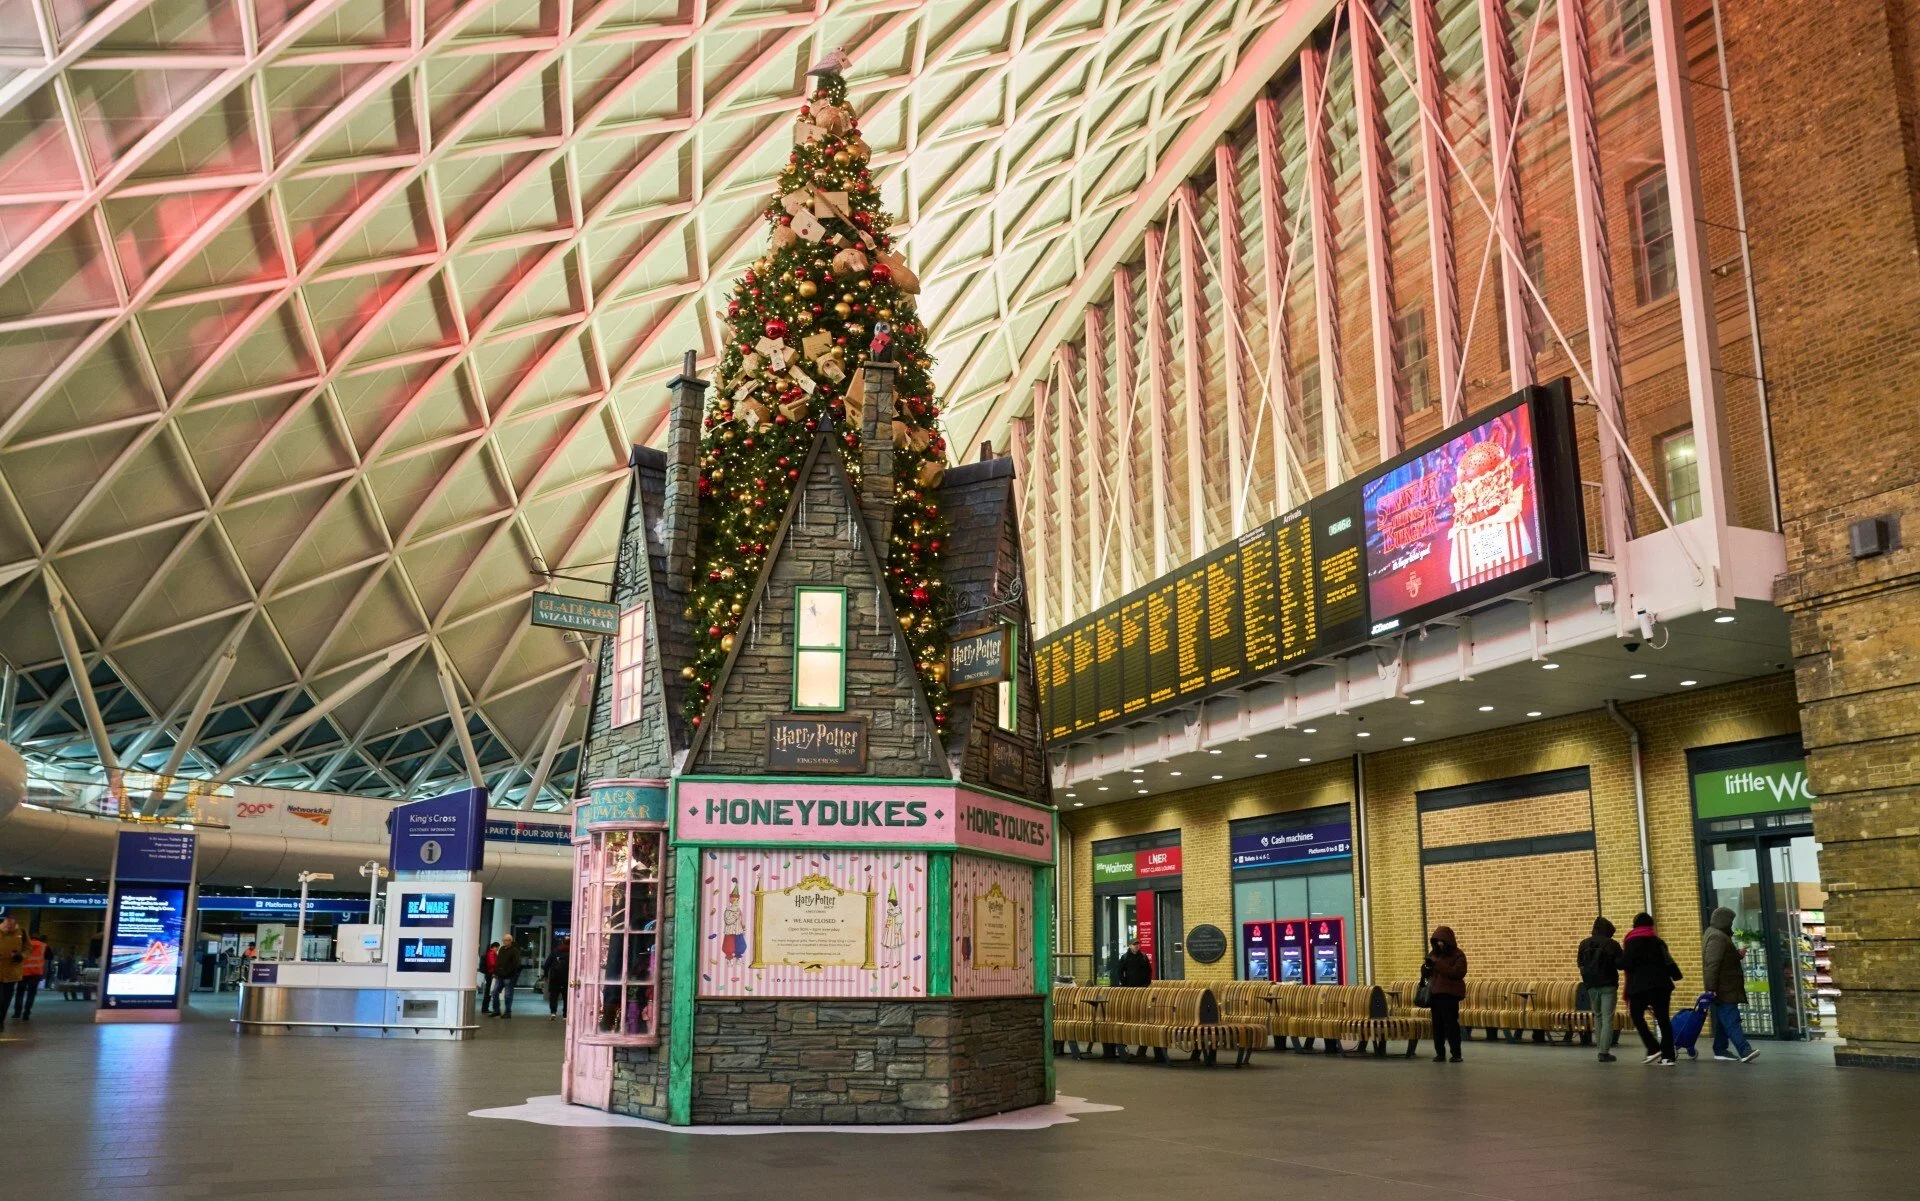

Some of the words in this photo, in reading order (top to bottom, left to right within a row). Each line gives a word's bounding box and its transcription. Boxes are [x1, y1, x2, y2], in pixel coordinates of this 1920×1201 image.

[952, 644, 975, 672] Harry
[976, 638, 1002, 662] Potter
[986, 659, 1000, 667] SHOP
[773, 726, 815, 752] Harry
[816, 724, 858, 749] Potter
[1725, 772, 1765, 794] little
[237, 802, 266, 818] 200
[706, 798, 927, 827] HONEYDUKES
[410, 814, 432, 824] King's
[434, 814, 456, 822] Cross
[966, 805, 1044, 846] HONEYDUKES
[489, 827, 508, 835] PART
[1271, 835, 1285, 845] Cash
[1286, 832, 1313, 843] machines
[1148, 853, 1167, 865] LNER
[1105, 862, 1133, 874] Waitrose
[795, 894, 815, 907] Harry
[815, 893, 836, 906] Potter
[342, 912, 351, 922] 9
